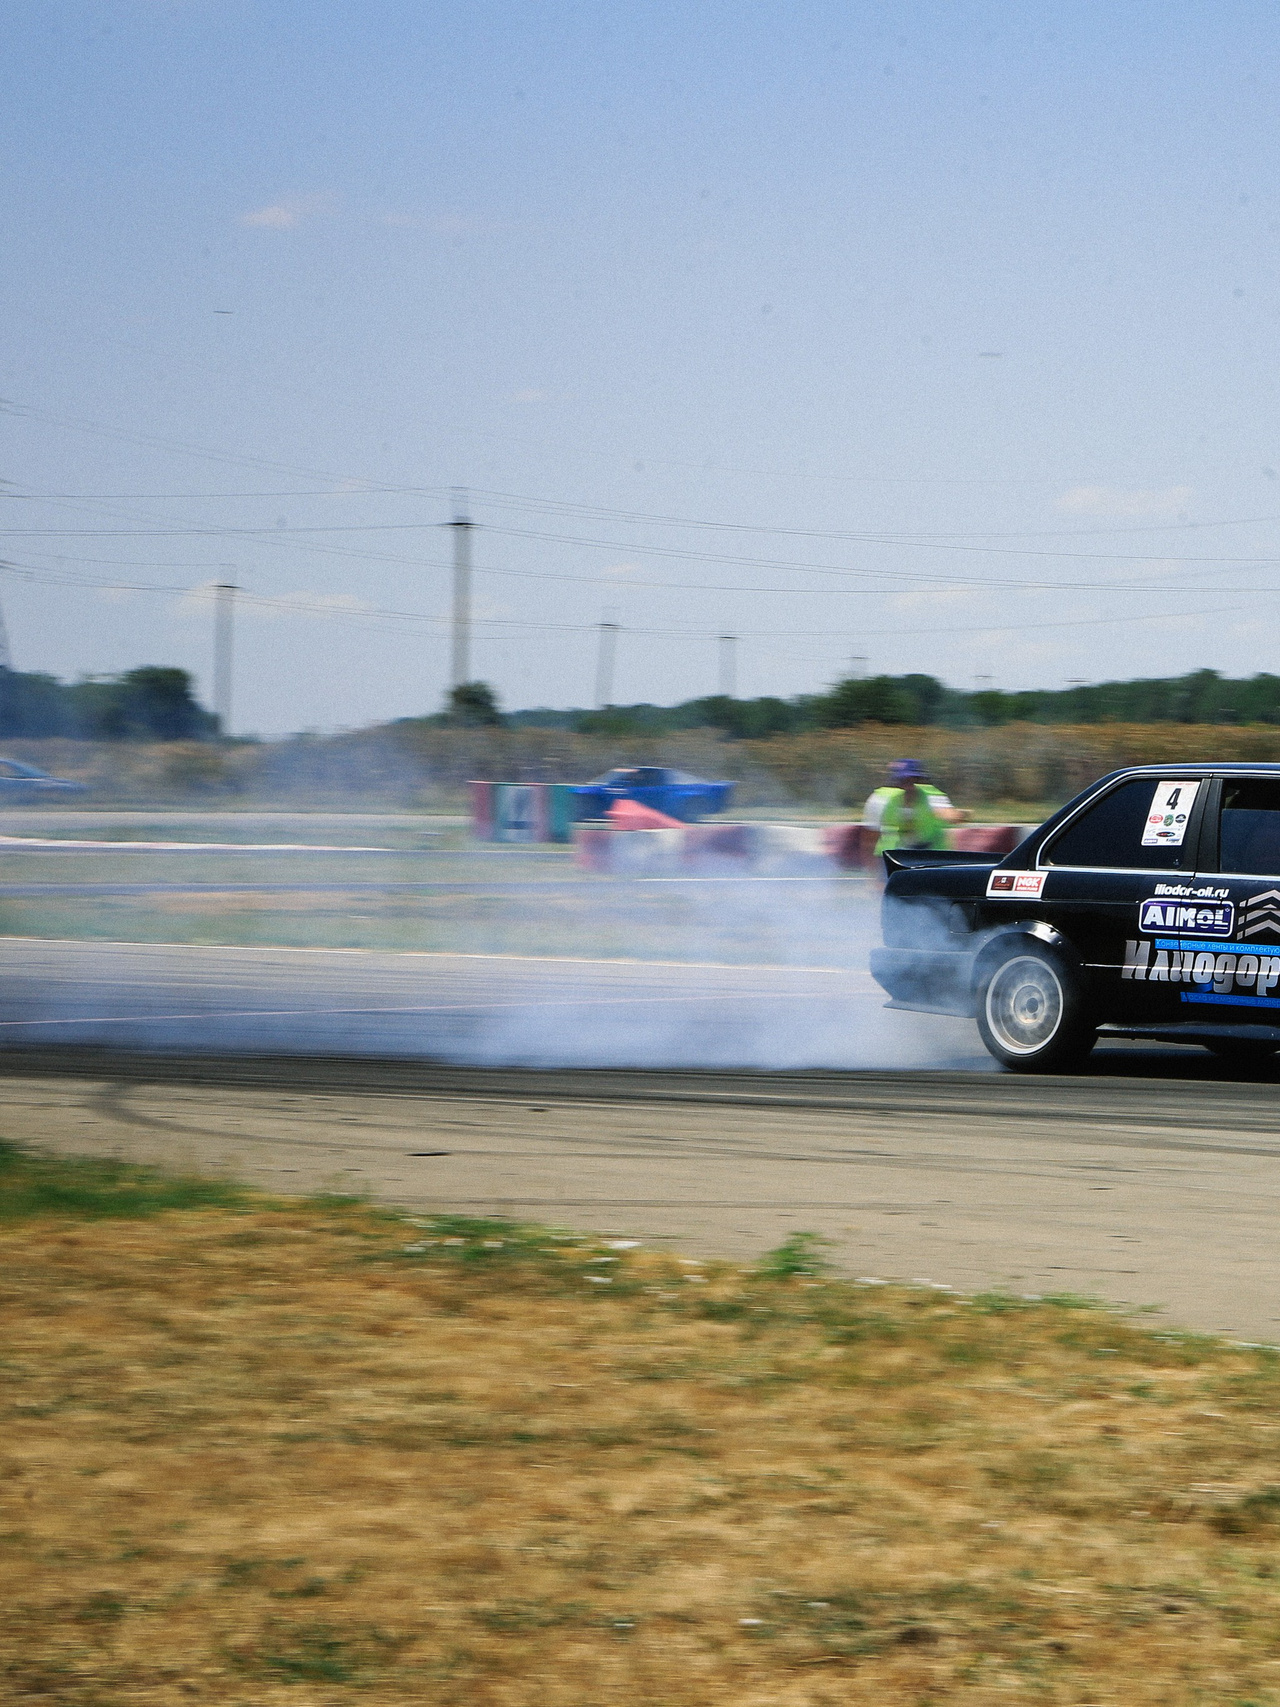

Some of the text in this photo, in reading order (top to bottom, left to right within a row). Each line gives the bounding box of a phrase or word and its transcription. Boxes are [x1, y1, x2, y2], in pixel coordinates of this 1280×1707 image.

[1166, 788, 1182, 810] 4
[1017, 877, 1041, 887] NGK
[1154, 883, 1230, 899] iliodor-oil.ru
[1142, 905, 1229, 930] AIMOL
